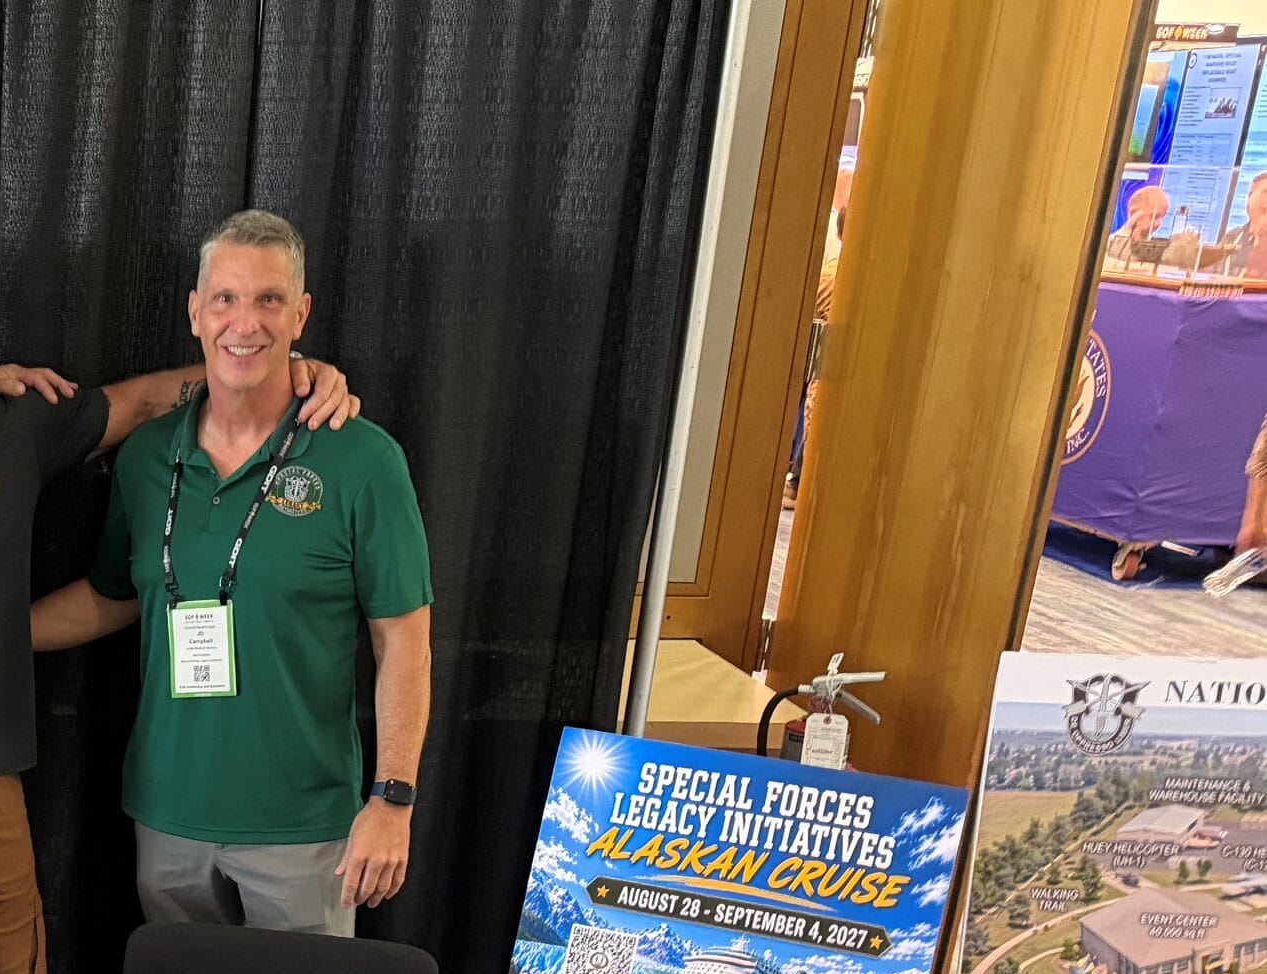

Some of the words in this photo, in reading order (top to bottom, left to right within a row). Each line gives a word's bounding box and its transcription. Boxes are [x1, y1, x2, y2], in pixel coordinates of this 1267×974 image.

[261, 465, 278, 494] GDIT
[165, 508, 173, 536] GDIT
[229, 538, 243, 568] GDIT
[1165, 680, 1267, 705] NATIO
[638, 762, 754, 814] SPECIAL
[761, 781, 875, 827] FORCES
[1149, 790, 1217, 804] WAREHOUSE
[1165, 778, 1239, 792] MAINTENANCE
[609, 792, 715, 840] LEGACY
[718, 813, 896, 870] INITIATIVES
[1083, 842, 1112, 853] HUEY
[587, 827, 769, 883] ALASKAN
[767, 857, 912, 908] CRUISE
[1032, 888, 1079, 902] WALKING
[617, 885, 677, 916] AUGUST
[680, 896, 701, 918] 28
[714, 904, 806, 939] SEPTEMBER
[809, 923, 824, 945] 4,
[827, 926, 869, 950] 2027
[1141, 914, 1173, 926] EVENT
[1176, 916, 1217, 927] CENTER
